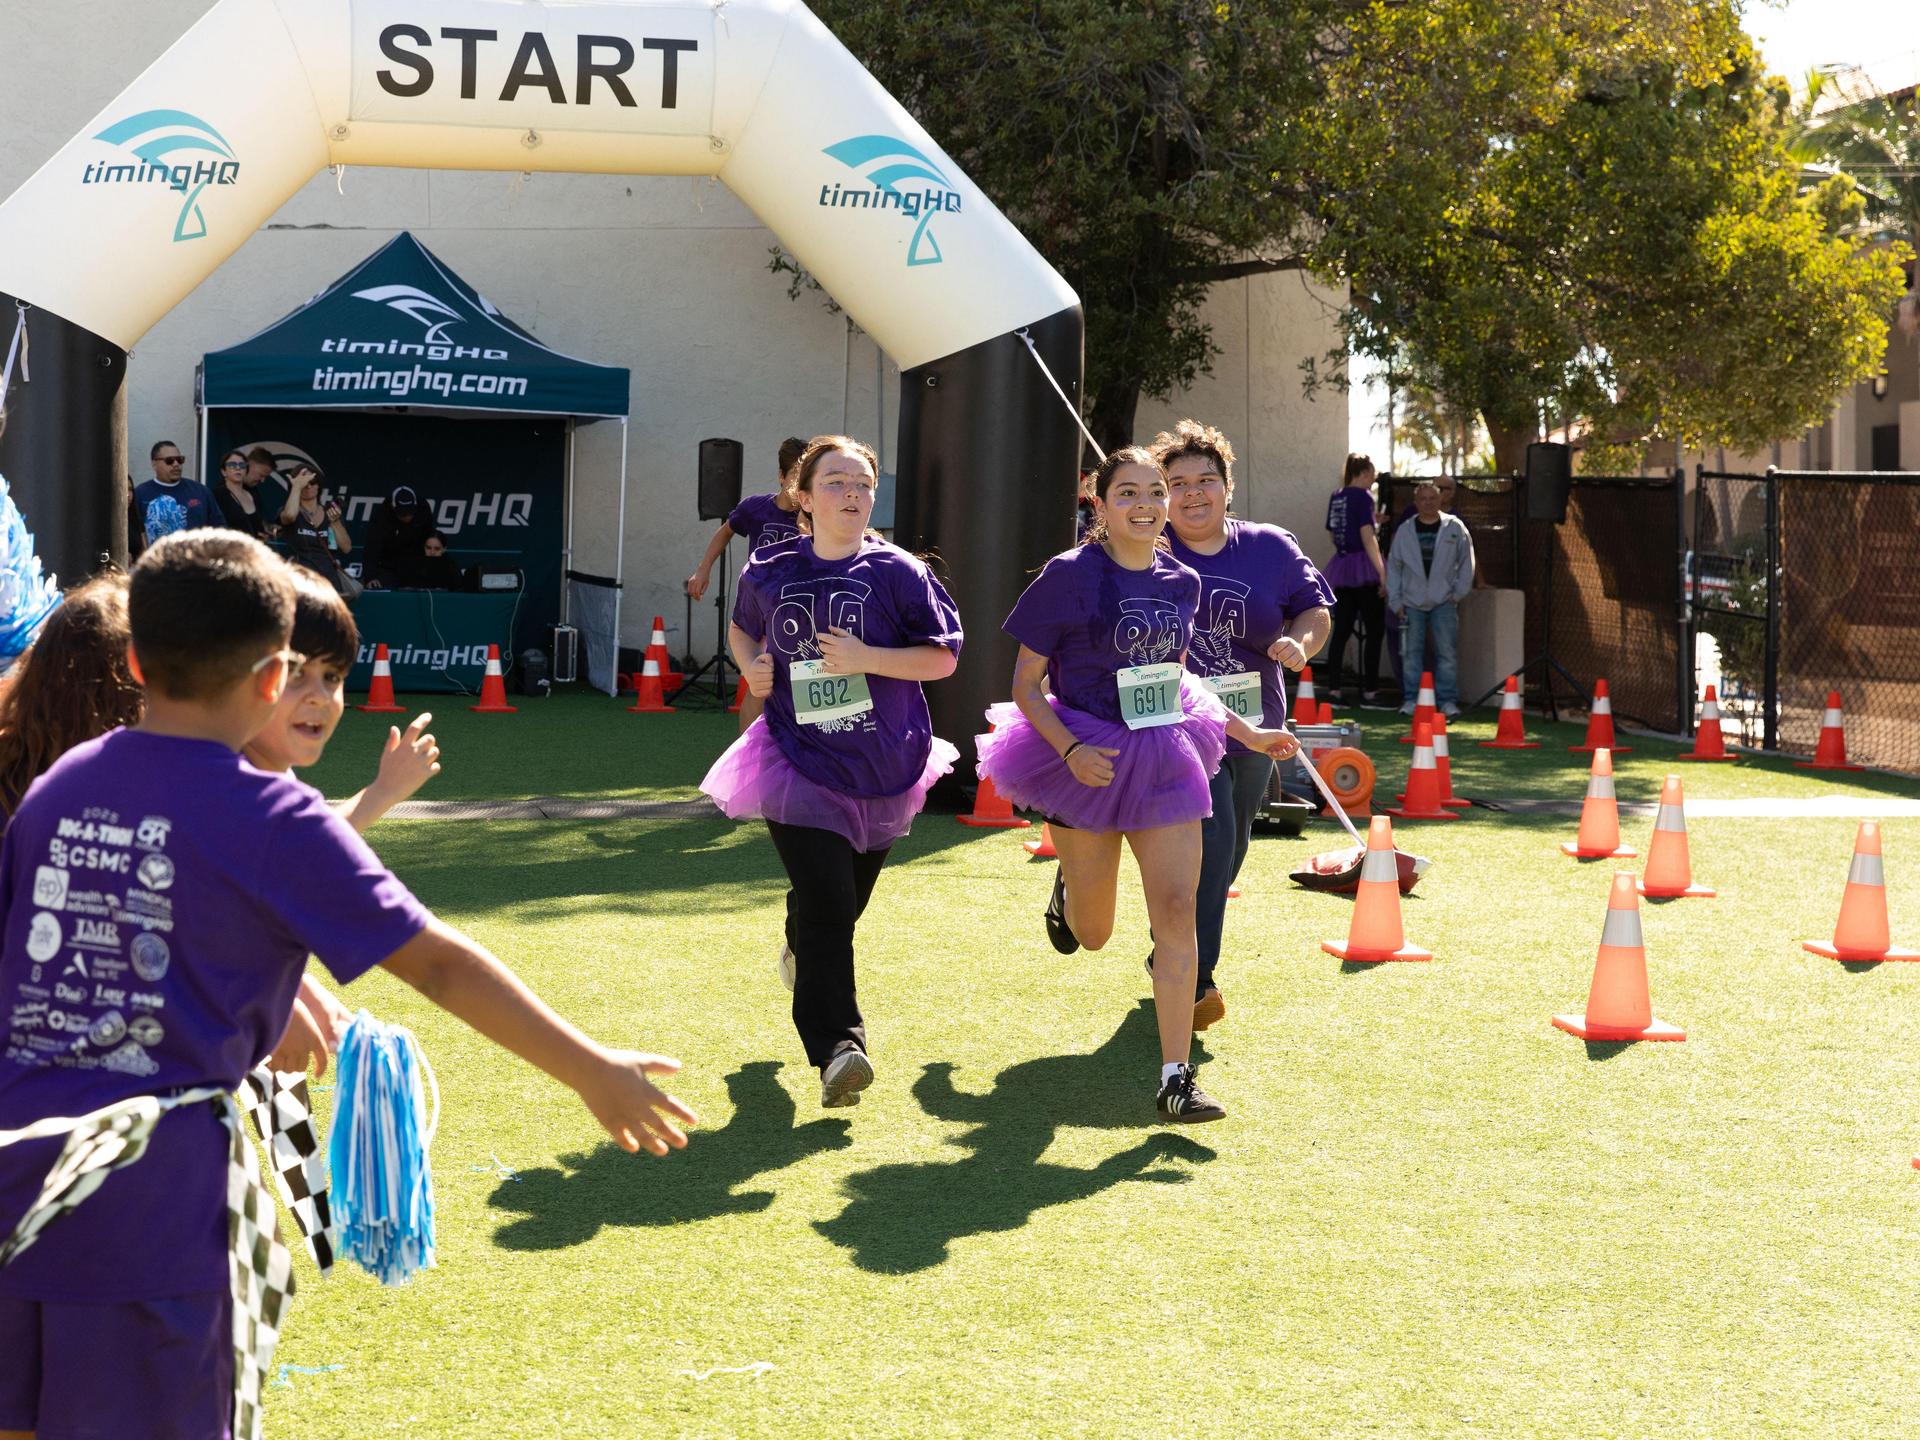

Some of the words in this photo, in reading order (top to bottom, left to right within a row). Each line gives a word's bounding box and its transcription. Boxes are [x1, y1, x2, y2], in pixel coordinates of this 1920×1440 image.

[376, 23, 698, 109] START
[82, 158, 240, 191] timingHQ
[819, 183, 962, 217] timingHQ
[321, 338, 508, 361] timingHQ
[312, 364, 528, 397] timinghq.com
[320, 486, 533, 535] tmgHQ
[1192, 574, 1252, 639] TA
[808, 678, 852, 708] 692
[1133, 684, 1167, 715] 691
[1217, 691, 1248, 716] 95
[69, 846, 131, 874] CSMC
